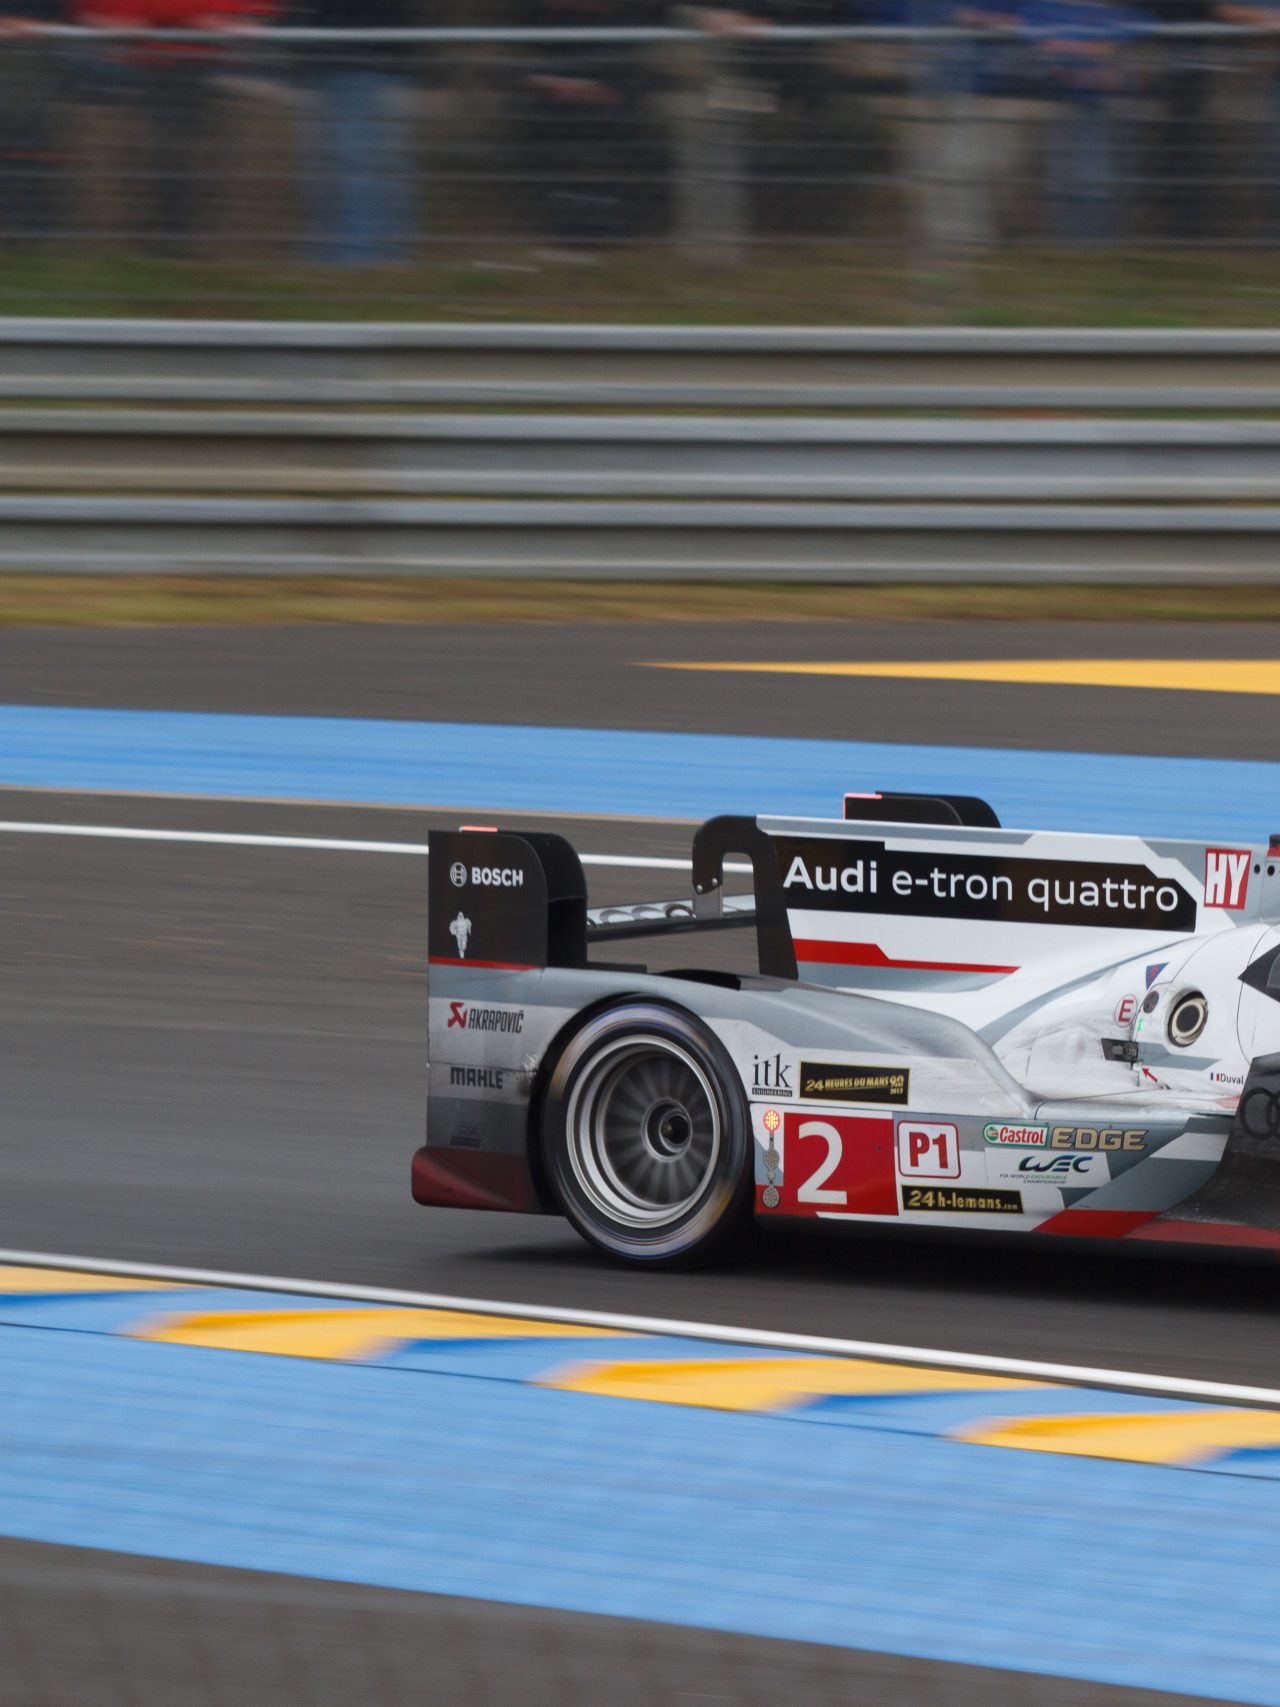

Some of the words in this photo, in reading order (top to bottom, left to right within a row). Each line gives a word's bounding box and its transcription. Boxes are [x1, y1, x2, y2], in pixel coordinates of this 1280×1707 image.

[471, 866, 524, 887] BOSCH
[783, 855, 878, 894] Audi
[892, 866, 1013, 901] e-tron
[1027, 877, 1179, 912] quattro
[1205, 852, 1249, 906] HY
[1118, 999, 1134, 1023] E
[450, 1066, 503, 1090] MAHLE
[752, 1052, 792, 1089] itk
[1220, 1073, 1244, 1085] Duval
[752, 1088, 792, 1097] ENGINEERING
[804, 1079, 824, 1092] 24
[825, 1077, 853, 1090] HEURES
[853, 1077, 866, 1088] DU
[866, 1075, 889, 1087] MANS
[909, 1130, 949, 1170] P1
[1000, 1126, 1045, 1145] Castrol
[1050, 1127, 1149, 1151] EDGE
[797, 1120, 848, 1205] 2
[1018, 1154, 1094, 1174] WEC
